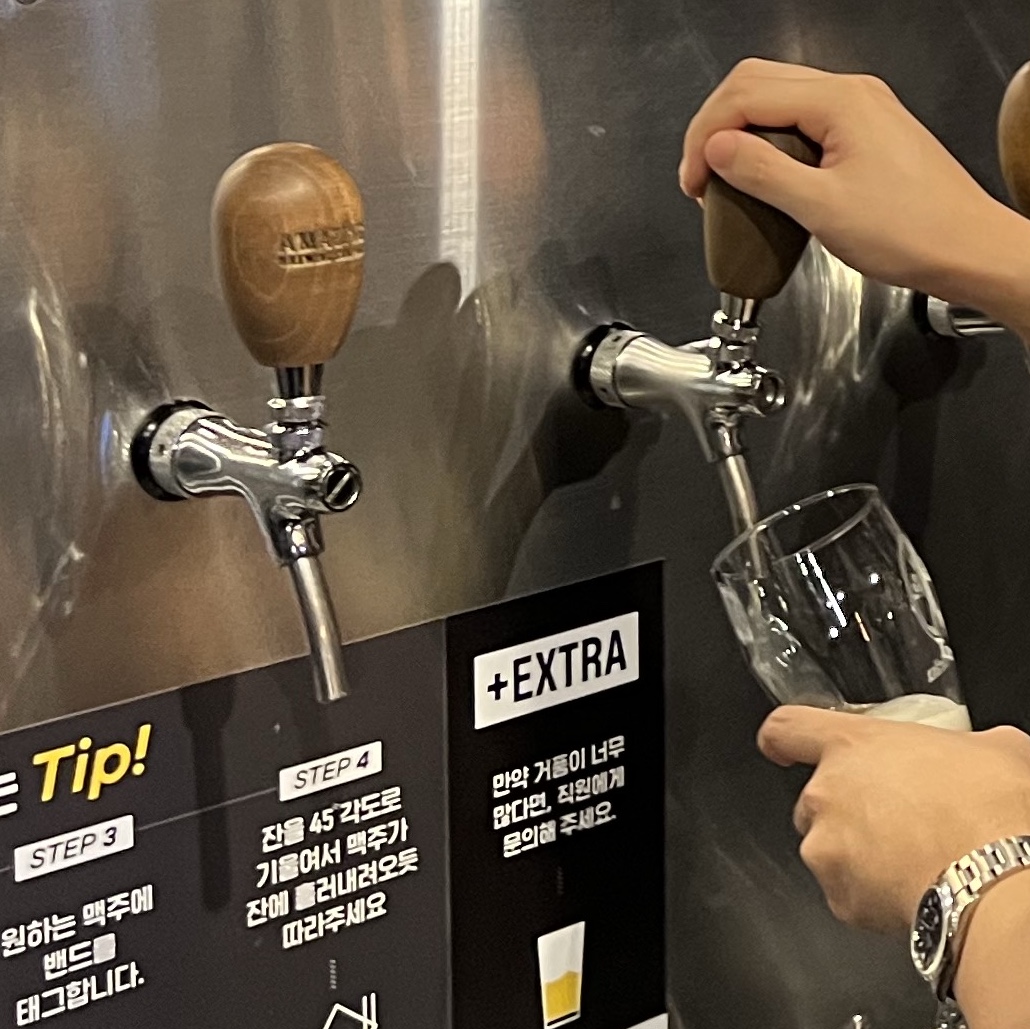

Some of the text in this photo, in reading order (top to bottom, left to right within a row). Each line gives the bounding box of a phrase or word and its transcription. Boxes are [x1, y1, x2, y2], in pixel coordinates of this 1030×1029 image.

[487, 630, 627, 702] +EXTRA
[33, 724, 151, 802] Tip!
[294, 750, 370, 790] STEP 4
[492, 735, 625, 798] 만약 거품이 너무
[557, 765, 625, 804] 직원에게
[30, 826, 118, 869] STEP 3
[256, 817, 409, 887] 기울여서 맥주가
[261, 817, 305, 853] 잔을
[503, 820, 557, 858] 문의해
[246, 847, 419, 928] 잔에 러내려오듯
[1, 884, 154, 958] 원하는 맥주에
[282, 891, 388, 949] 따라주세요
[43, 932, 117, 981] 밴드
[16, 961, 145, 1027] 태그합니다.
